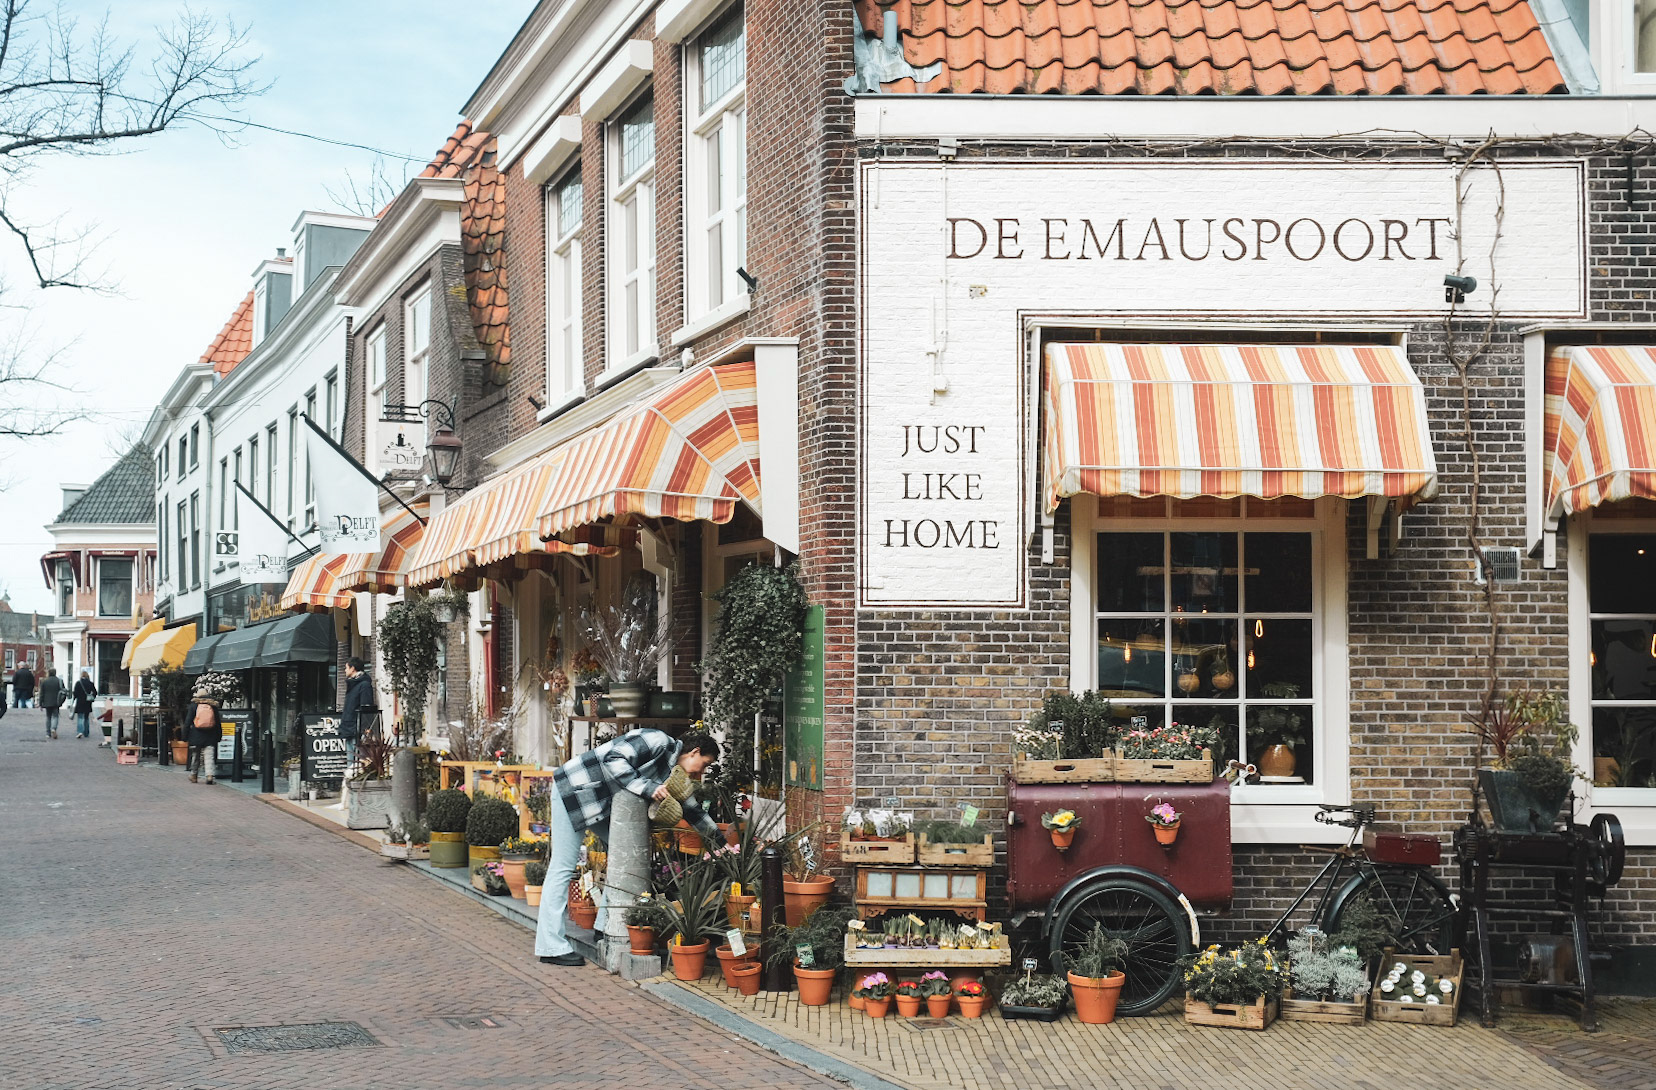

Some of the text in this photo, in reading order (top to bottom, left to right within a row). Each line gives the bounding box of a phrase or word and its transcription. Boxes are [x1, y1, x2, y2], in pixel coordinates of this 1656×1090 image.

[947, 217, 1452, 262] DE EMAUSPOORT
[902, 425, 986, 458] JUST
[902, 472, 983, 500] LIKE
[333, 514, 377, 531] DELFT
[881, 518, 999, 549] HOME
[256, 553, 287, 566] DELFT
[312, 738, 347, 753] OPEN
